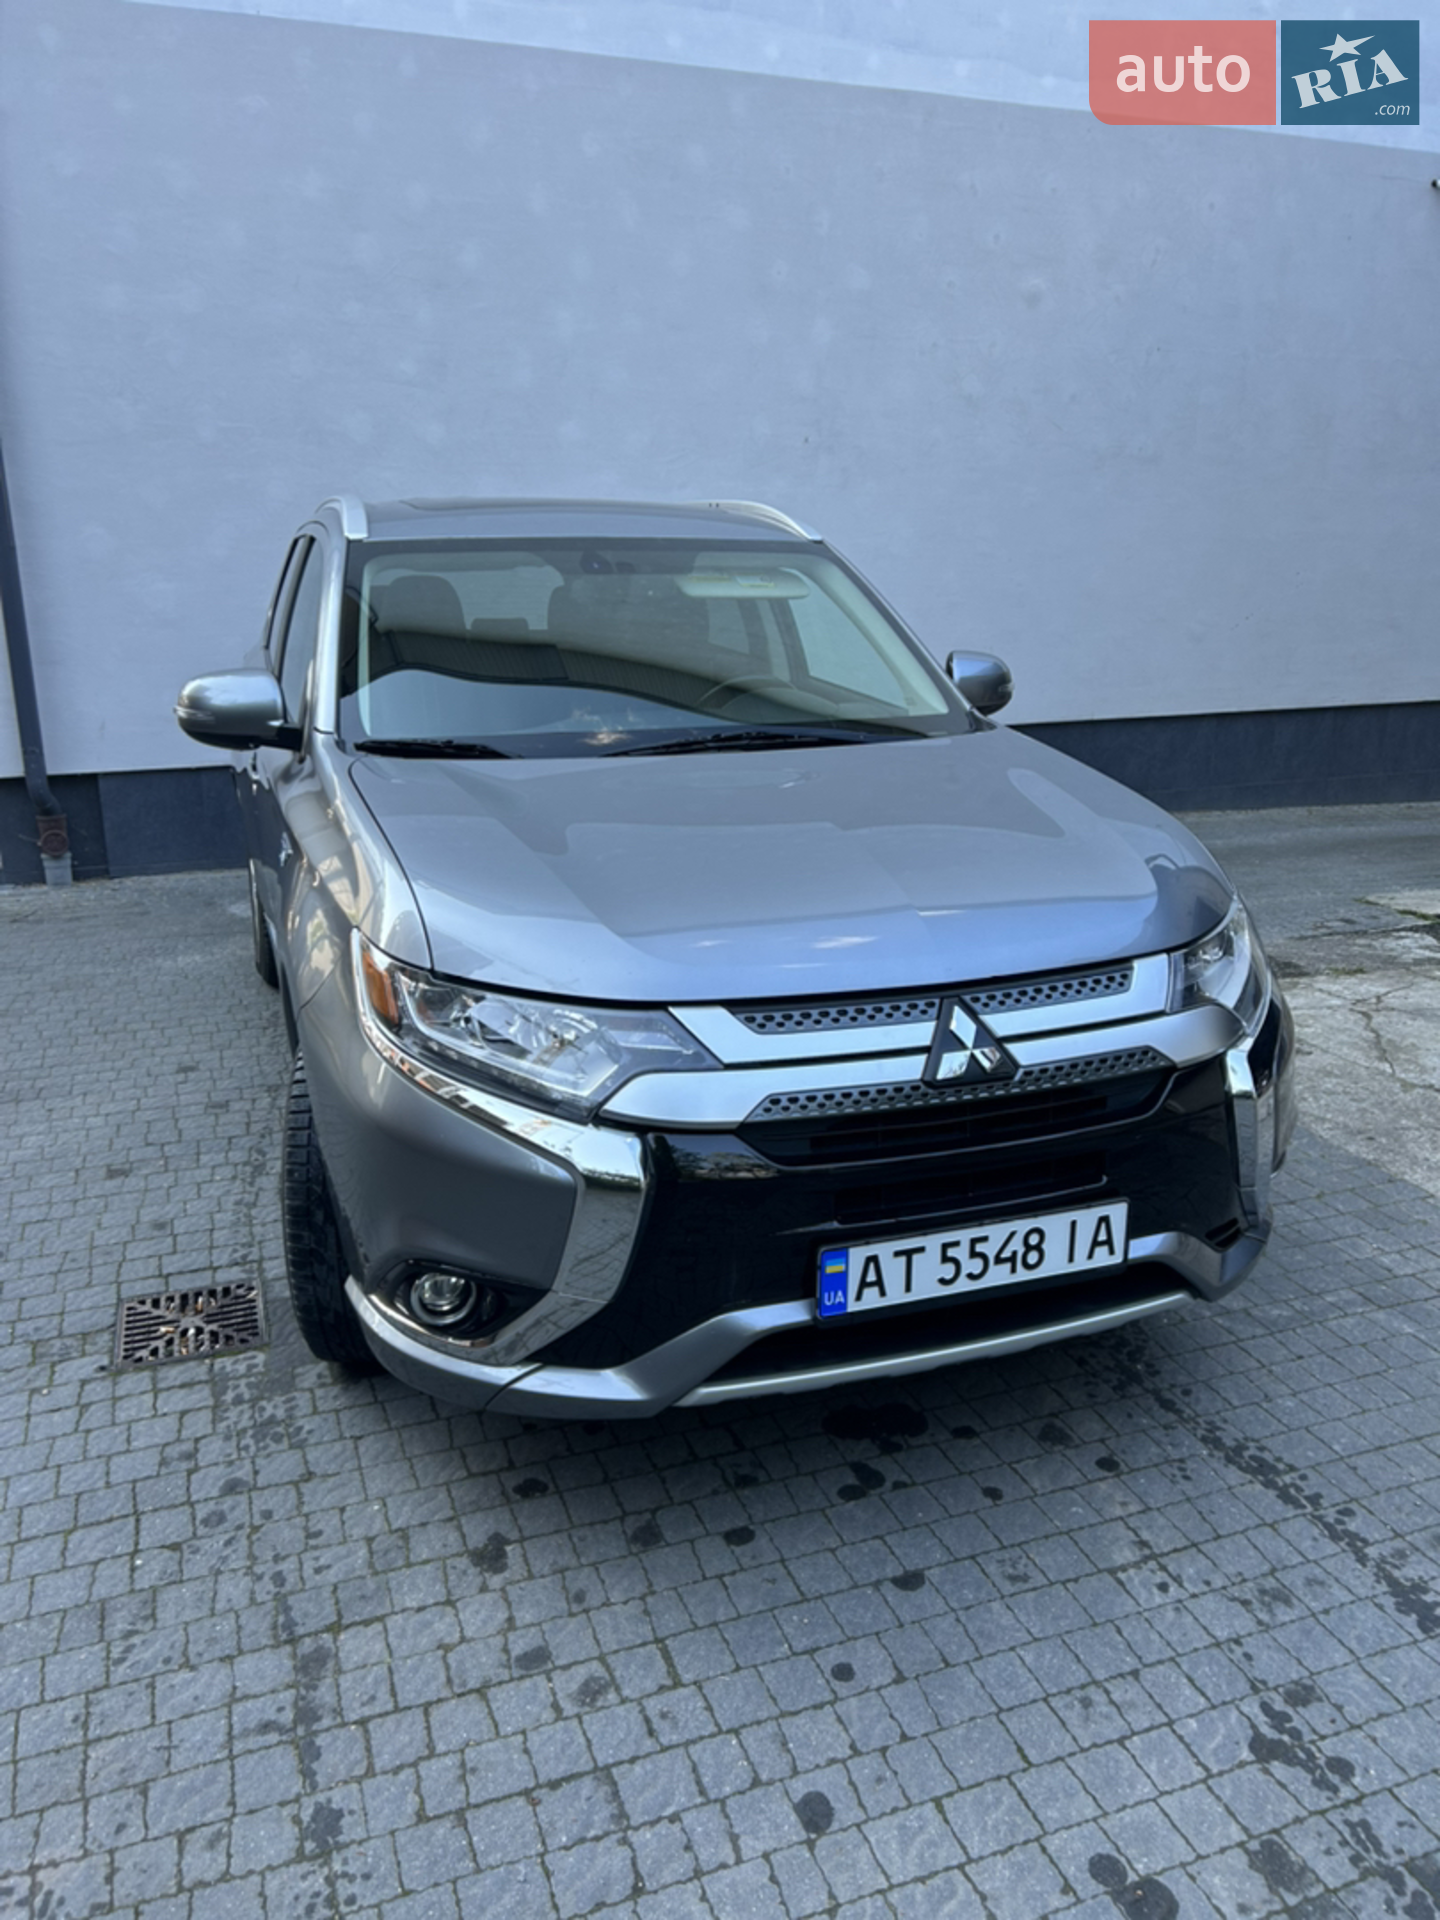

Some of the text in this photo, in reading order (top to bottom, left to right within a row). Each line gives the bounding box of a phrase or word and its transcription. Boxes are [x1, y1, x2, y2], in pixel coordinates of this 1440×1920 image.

[854, 1214, 1116, 1302] AT 5548 IA
[824, 1290, 845, 1306] UA
